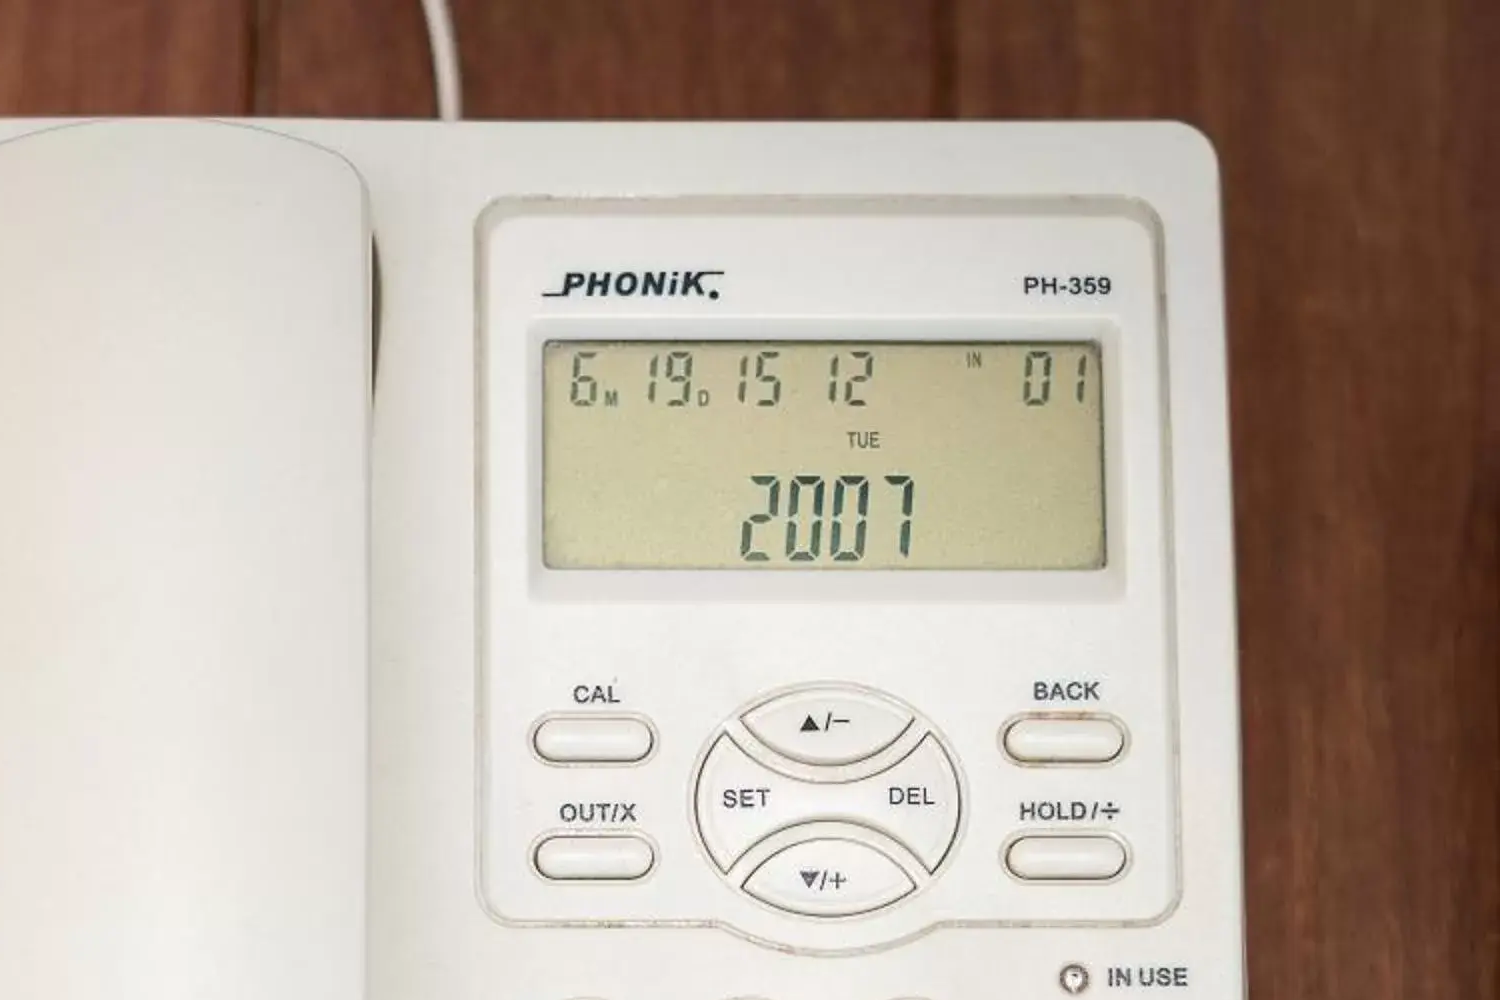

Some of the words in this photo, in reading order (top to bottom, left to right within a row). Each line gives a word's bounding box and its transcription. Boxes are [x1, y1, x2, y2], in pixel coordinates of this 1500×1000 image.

[1023, 276, 1112, 296] PH-359
[737, 350, 782, 407] 15
[828, 350, 875, 407] 12
[966, 351, 982, 368] IN
[1022, 350, 1088, 407] 01
[846, 431, 881, 449] TUE
[739, 474, 915, 562] 2007
[573, 684, 621, 705] CAL
[1033, 681, 1100, 701] BACK
[722, 788, 771, 809] SET
[888, 786, 936, 806] DEL
[559, 802, 637, 823] OUT/X
[1107, 967, 1132, 988] IN
[1138, 967, 1189, 987] USE
